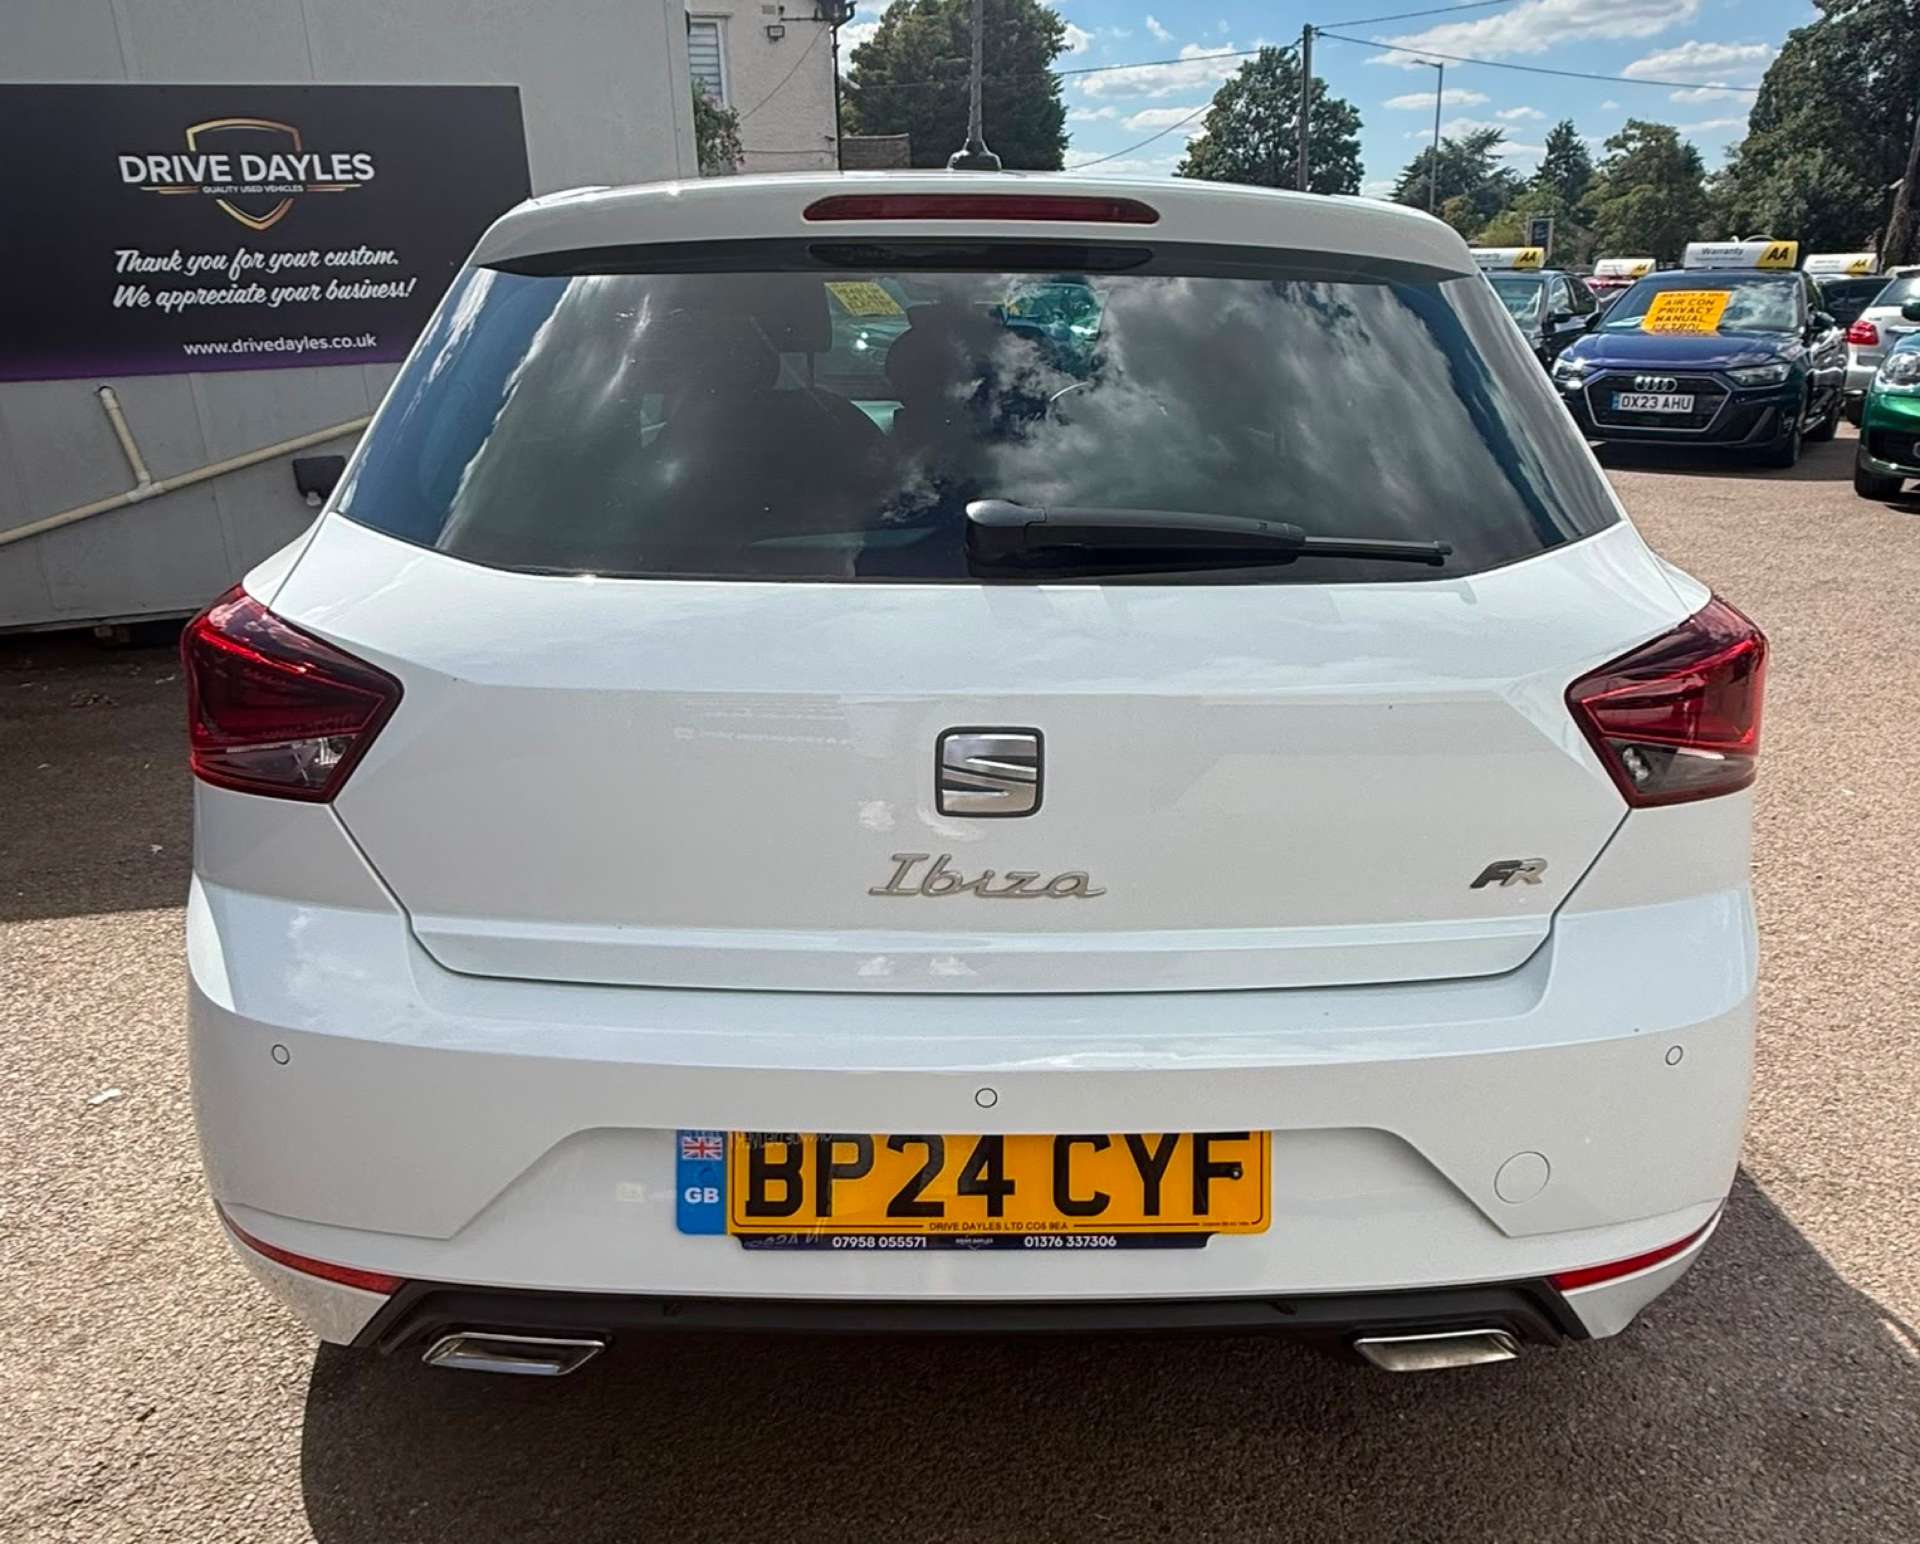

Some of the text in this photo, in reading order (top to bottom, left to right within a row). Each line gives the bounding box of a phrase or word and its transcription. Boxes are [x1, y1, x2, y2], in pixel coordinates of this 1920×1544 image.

[119, 153, 375, 183] DRIVE DAYLES
[202, 184, 304, 194] QUALITY USED VEHICLES
[1520, 251, 1537, 263] AA
[1701, 247, 1744, 256] Warranty
[1767, 247, 1790, 261] AA
[115, 245, 400, 281] Thank you for your custom.
[113, 277, 417, 313] We appreciate your business!
[1687, 298, 1715, 306] CON
[1657, 306, 1714, 314] PRIVACY
[1654, 315, 1705, 323] MANUAL
[184, 332, 377, 355] www.drivedayles.co.uk
[1621, 395, 1692, 410] OX23 AHU
[868, 853, 1107, 898] Ibiza
[1470, 858, 1548, 889] FR
[745, 1131, 1250, 1217] BP24 CYF
[684, 1187, 720, 1203] GB
[929, 1222, 959, 1231] DRIVE
[962, 1222, 1002, 1231] DAYLES
[1004, 1222, 1024, 1231] LTD
[832, 1236, 876, 1248] 07958
[878, 1236, 927, 1248] 055571
[1024, 1235, 1118, 1248] 01376 337306
